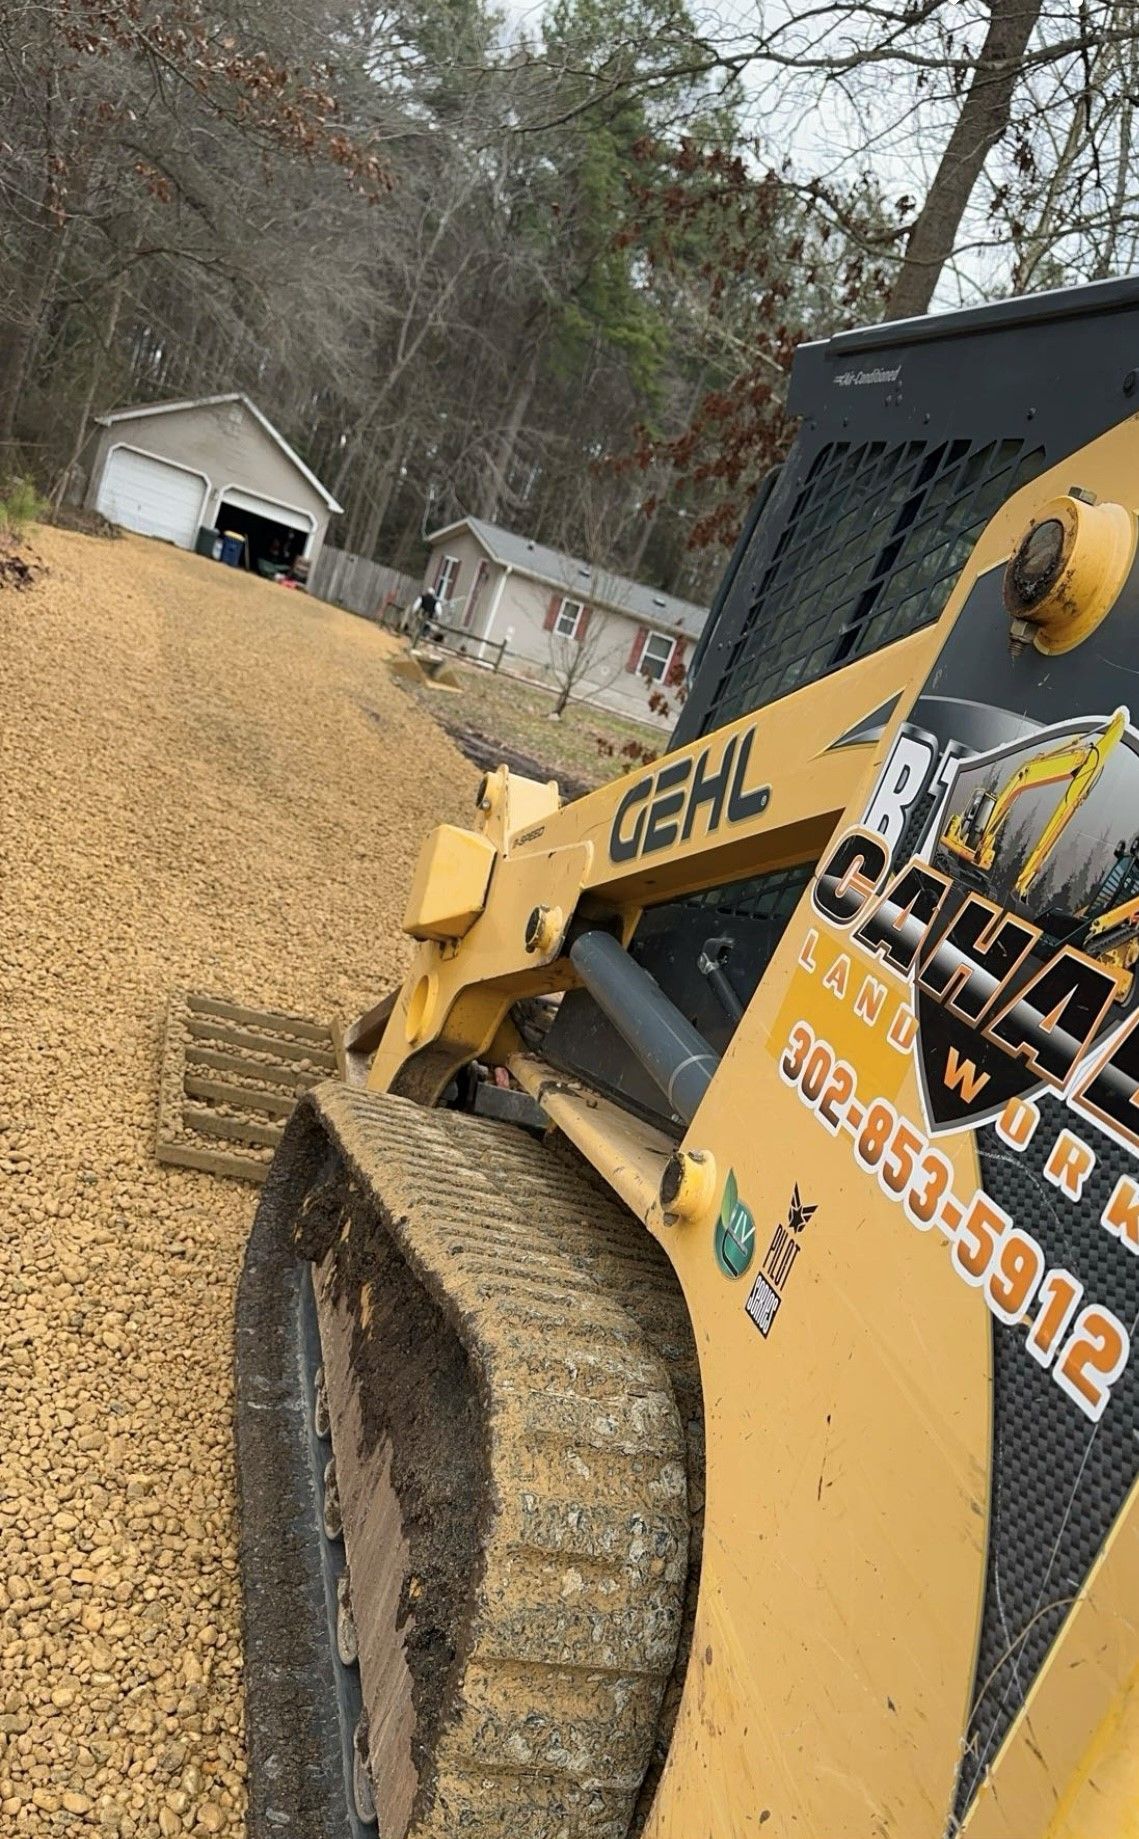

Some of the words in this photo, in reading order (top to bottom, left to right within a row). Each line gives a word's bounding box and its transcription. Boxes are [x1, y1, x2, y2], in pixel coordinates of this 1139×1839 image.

[609, 723, 772, 864] GEHL
[762, 1223, 801, 1292] PILOT
[779, 1020, 1129, 1421] 302-853-5912
